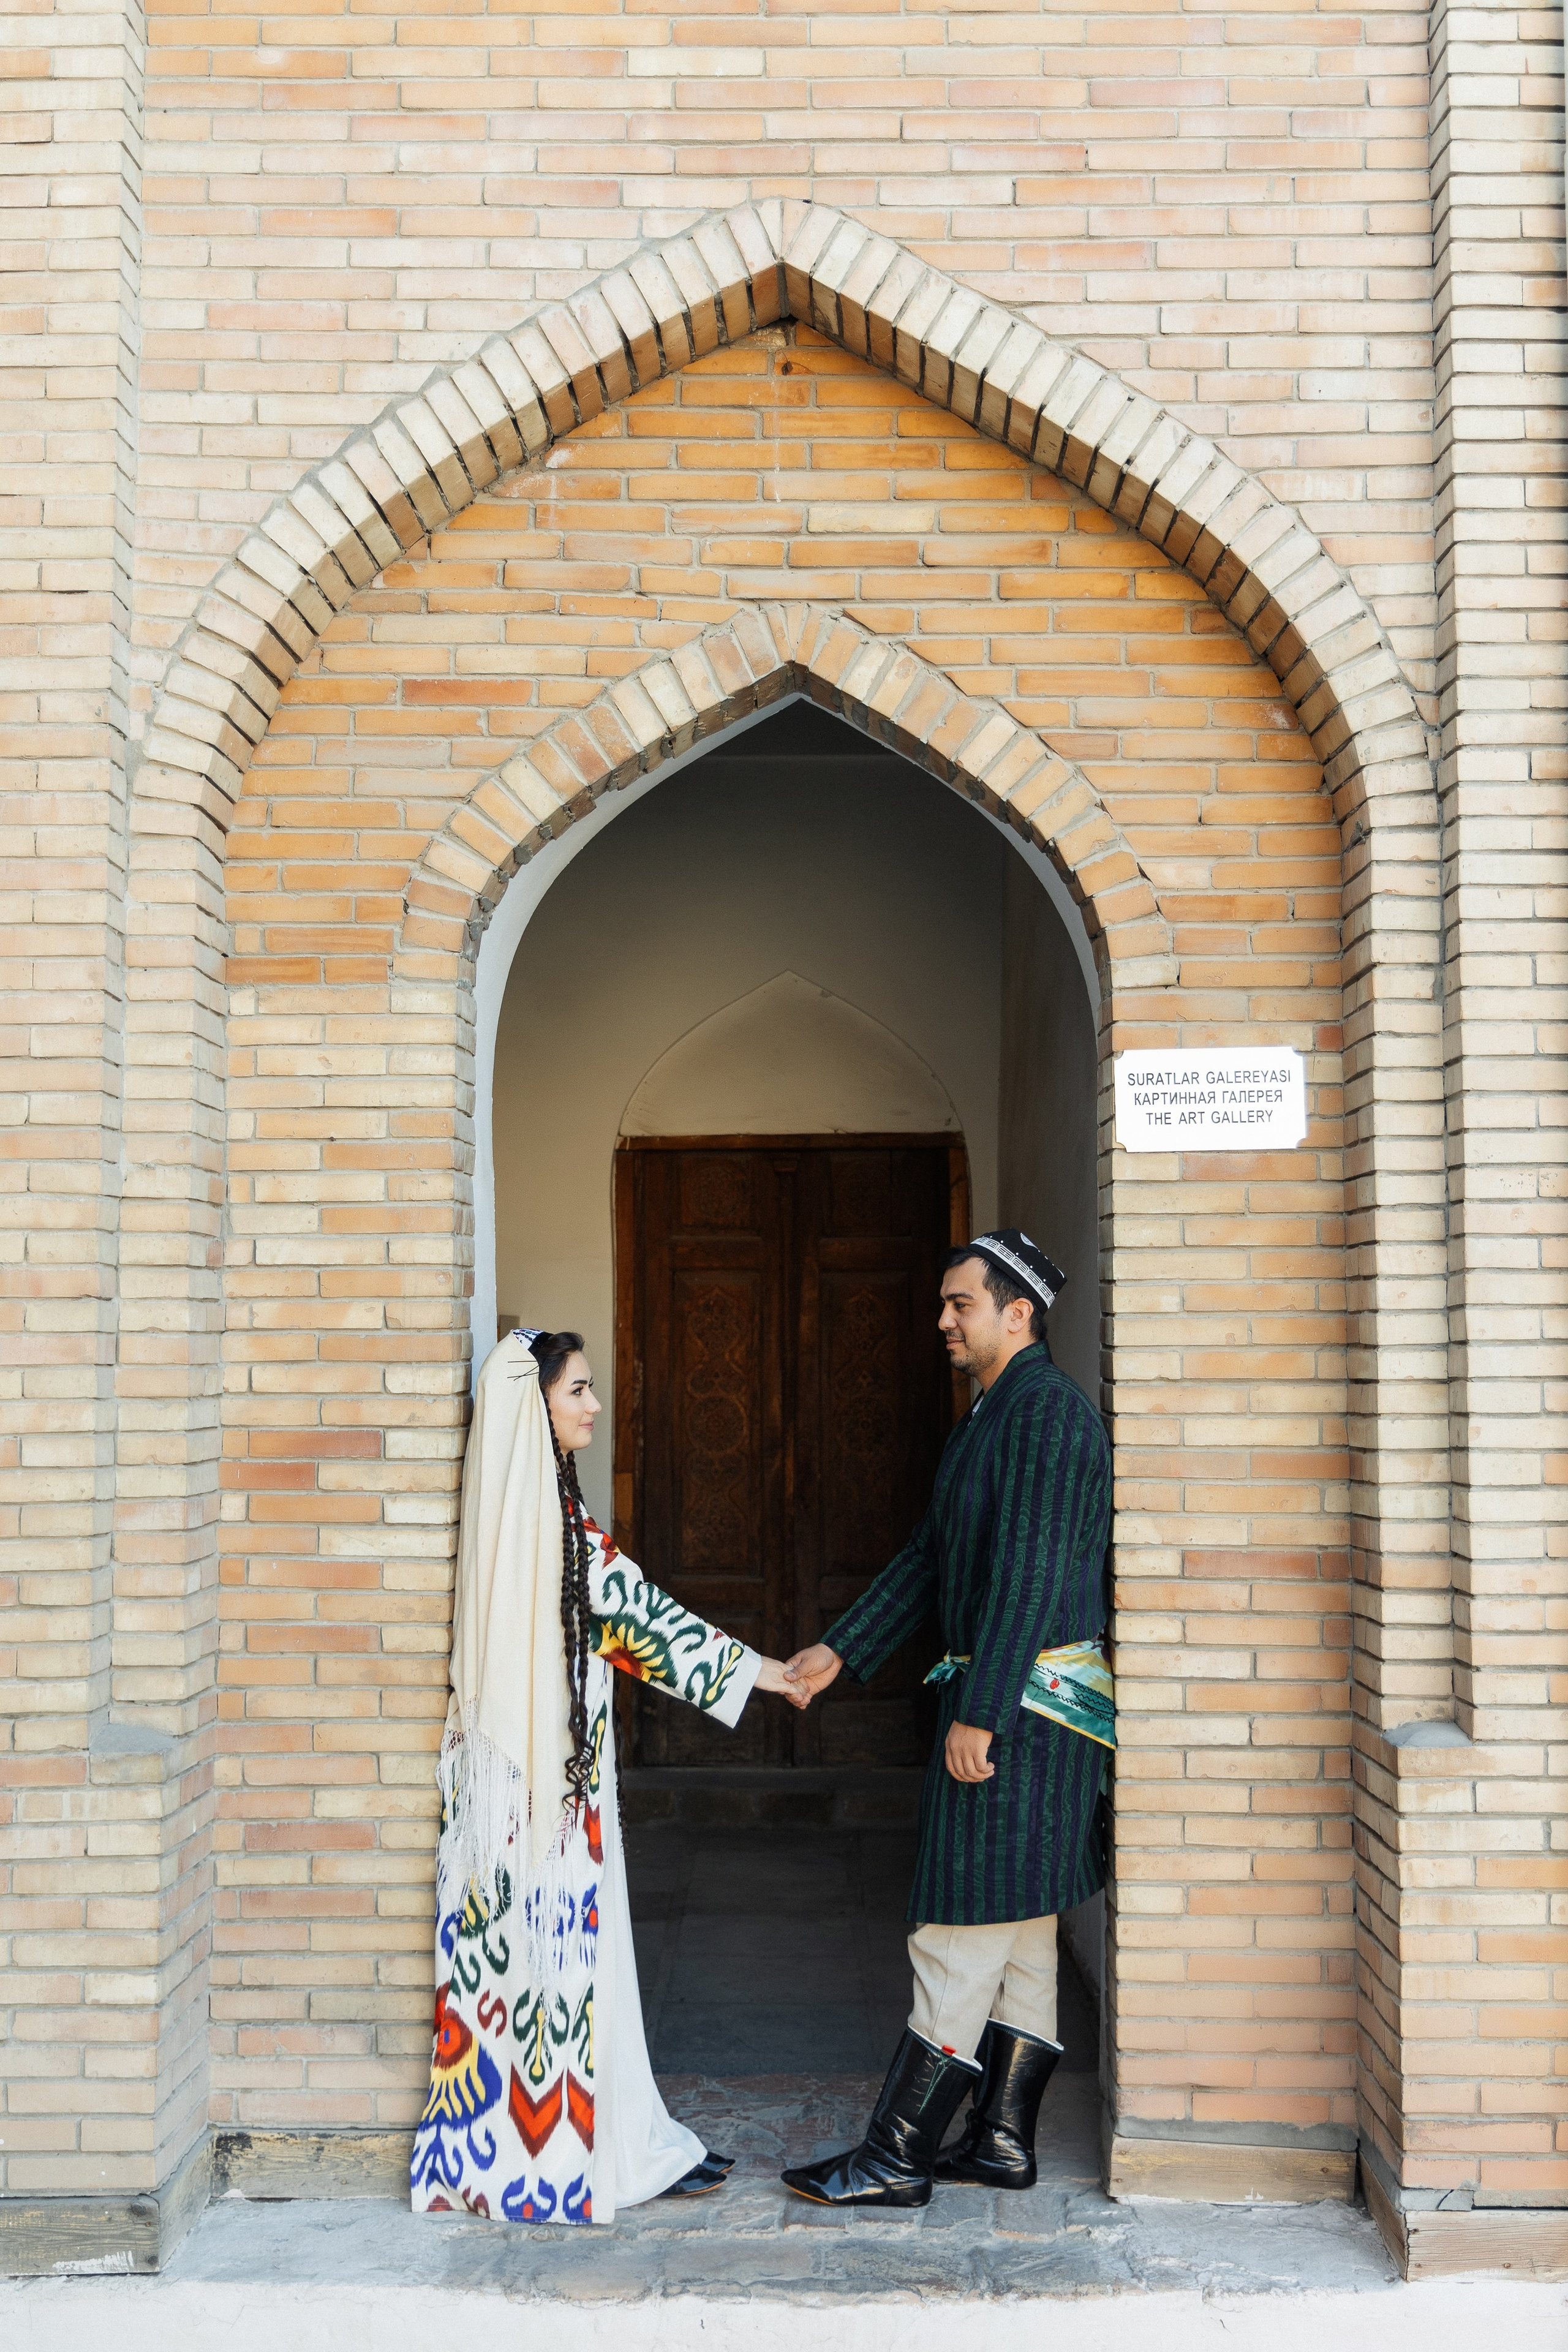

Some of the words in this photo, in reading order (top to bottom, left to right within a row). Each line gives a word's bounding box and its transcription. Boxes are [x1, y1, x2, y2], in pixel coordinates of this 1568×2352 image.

[1128, 1071, 1200, 1086] SURATLAR
[1205, 1070, 1291, 1084] GALEREYASI
[1134, 1091, 1216, 1106] КАРТИННАЯ
[1222, 1090, 1283, 1103] ГАЛЕРЕЯ
[1146, 1112, 1172, 1125] THE
[1178, 1111, 1206, 1125] ART
[1211, 1110, 1273, 1124] GALLERY
